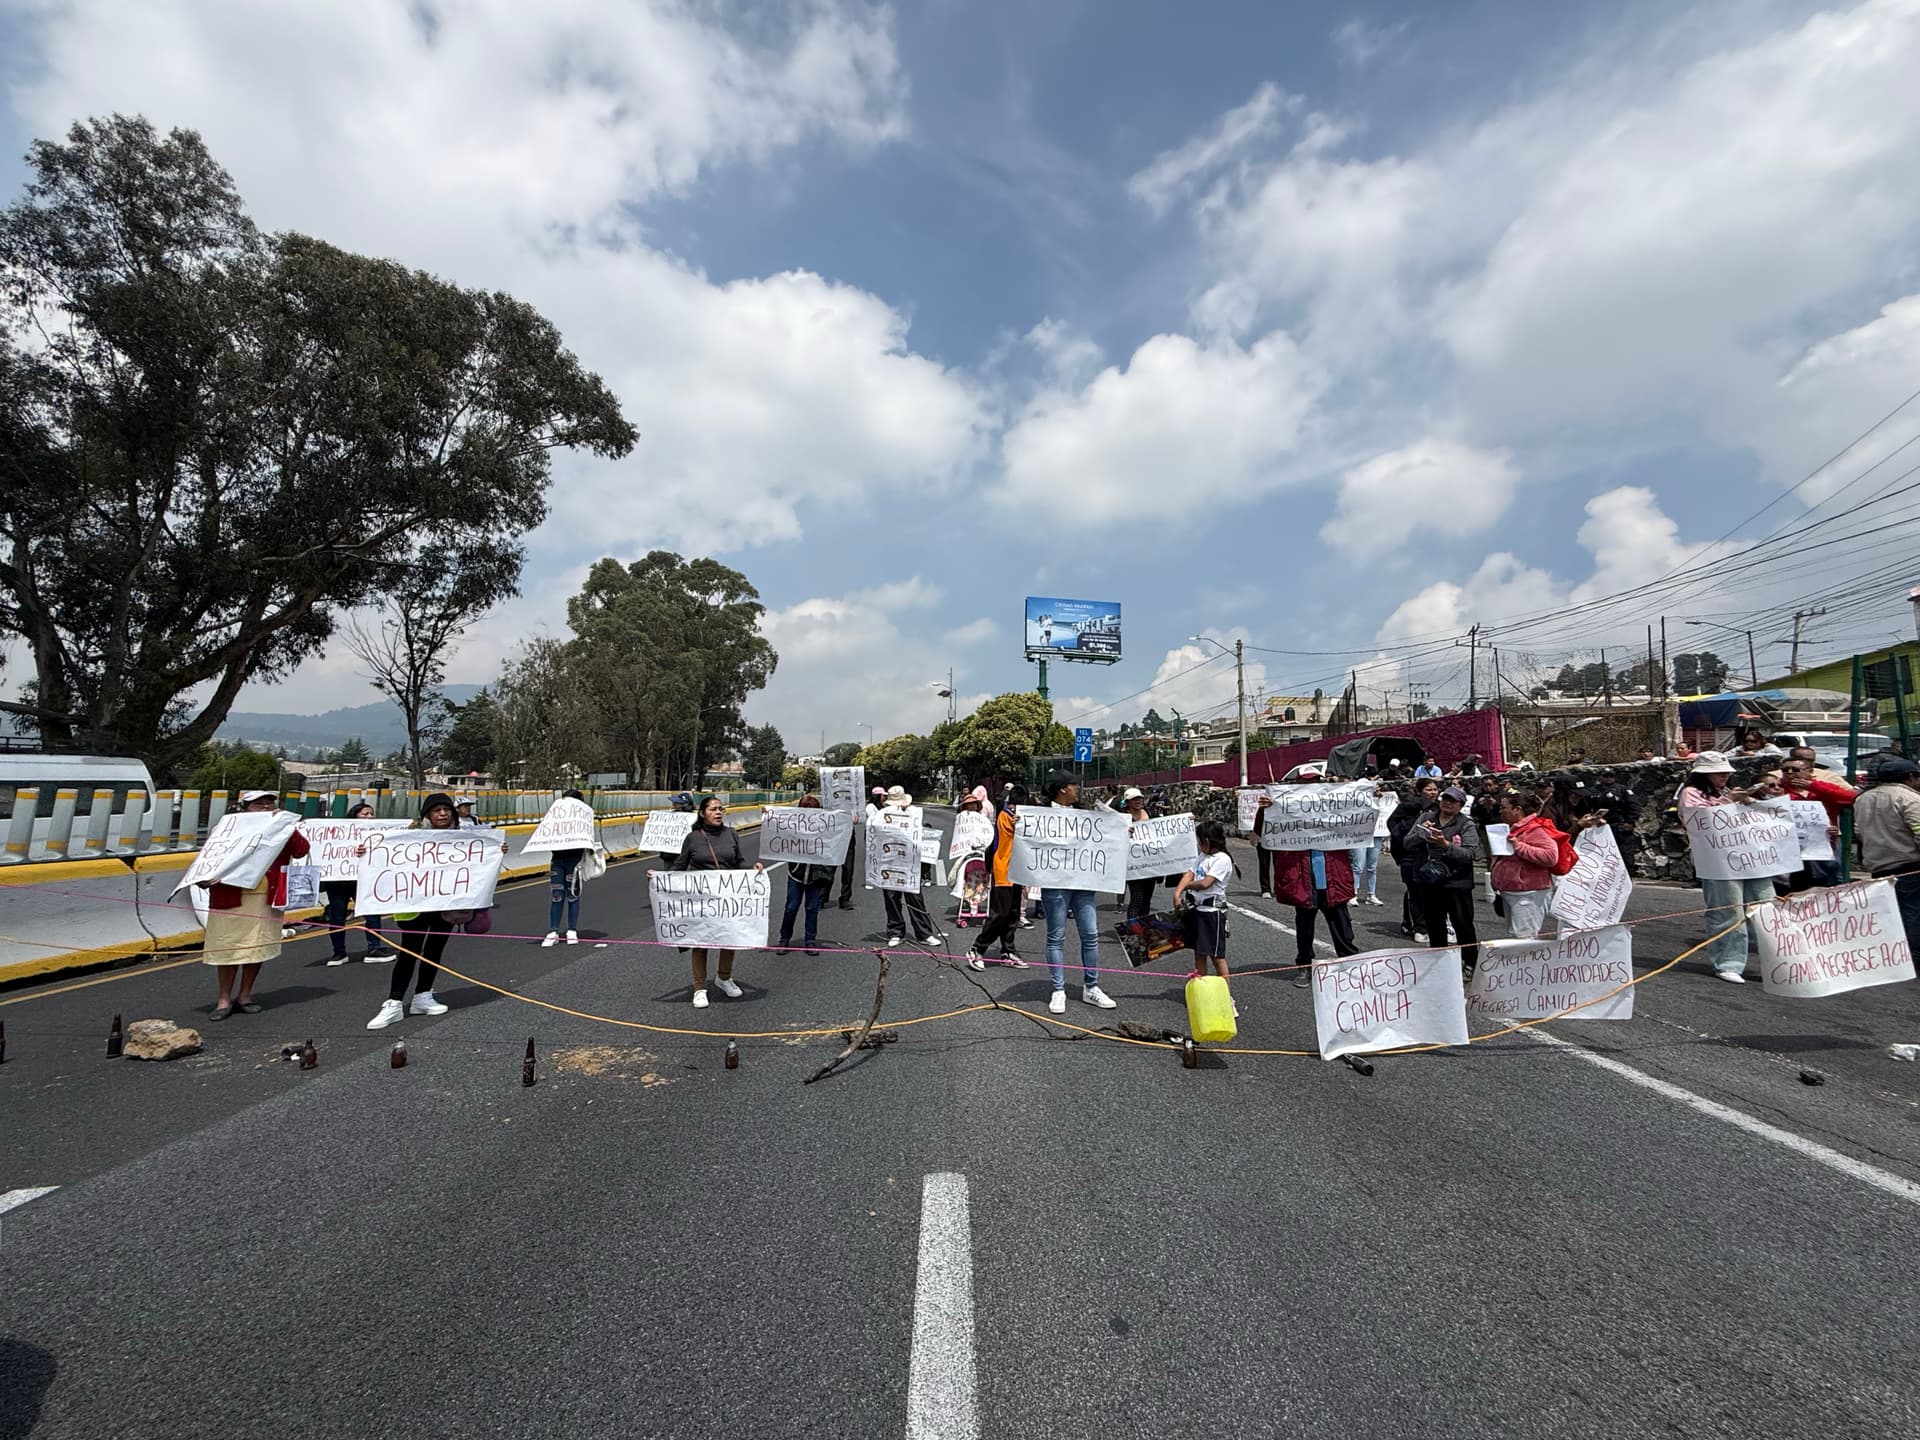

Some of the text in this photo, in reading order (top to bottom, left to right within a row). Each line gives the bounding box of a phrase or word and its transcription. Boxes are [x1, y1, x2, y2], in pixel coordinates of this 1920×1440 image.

[1276, 790, 1294, 814] TE
[1300, 790, 1373, 813] QUEREMOS
[766, 809, 836, 834] REGRESA
[1022, 815, 1104, 843] EXIGIMOS
[1152, 817, 1195, 837] REGRESA
[1264, 818, 1325, 835] DEVUELTA
[1328, 812, 1375, 828] CAMILA
[1687, 811, 1709, 831] TE
[1768, 805, 1787, 820] DE
[243, 833, 263, 855] A
[363, 833, 485, 869] REGRESA
[769, 836, 824, 856] CAMILA
[1130, 841, 1167, 858] CASA
[1705, 830, 1747, 849] VUELTA
[1027, 847, 1107, 876] JUSTICIA
[1727, 846, 1778, 872] CAMILA
[373, 867, 470, 903] CAMILA
[656, 872, 766, 896] NI UNA MAS
[680, 898, 695, 918] LA
[1825, 888, 1848, 914] DE
[1846, 886, 1868, 910] TU
[660, 922, 688, 939] CAS
[1803, 917, 1838, 950] PARA
[1844, 911, 1882, 941] QUE
[1558, 936, 1600, 960] APOYO
[1313, 956, 1417, 999] REGRESA
[1485, 961, 1630, 992] DE LAS AUTORIDADES
[1336, 989, 1412, 1034] CAMILA
[1468, 988, 1577, 1014] REGRESA CAMILA
